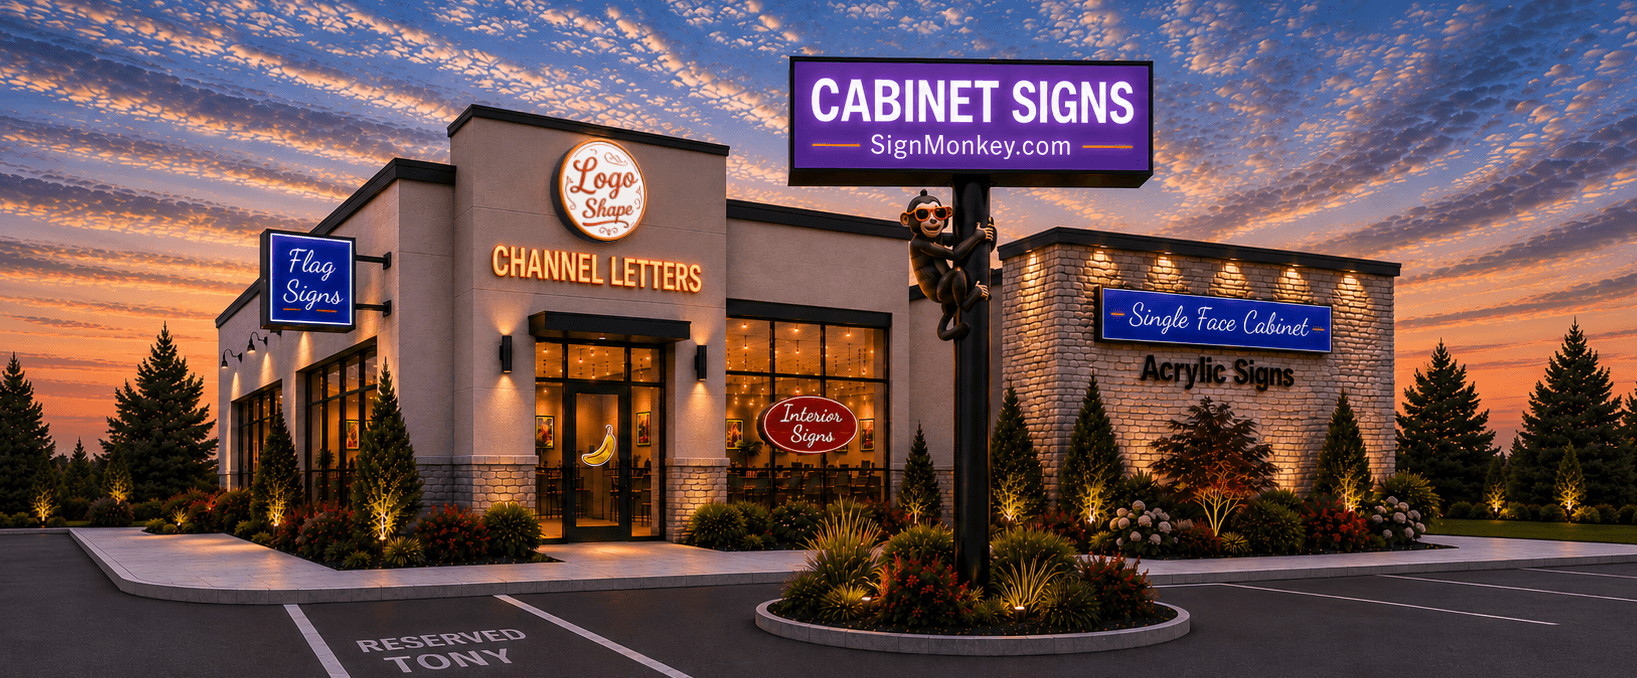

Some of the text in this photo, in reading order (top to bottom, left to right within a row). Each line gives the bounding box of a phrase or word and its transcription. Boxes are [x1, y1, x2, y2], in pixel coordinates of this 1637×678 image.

[811, 77, 1135, 125] CABINET SIGNS
[870, 133, 1071, 159] SignMonkey.com
[570, 156, 639, 200] Logo
[582, 197, 634, 224] Shape
[289, 247, 336, 282] Flag
[492, 244, 702, 293] CHANNEL LETTERS
[283, 278, 344, 311] Signs
[1129, 301, 1310, 337] Single Face Cabinet
[1139, 354, 1295, 391] Acrylic Signs
[780, 403, 843, 423] Interior
[790, 423, 835, 449] Signs
[355, 628, 527, 653] RESERVED
[383, 648, 513, 674] TONY
